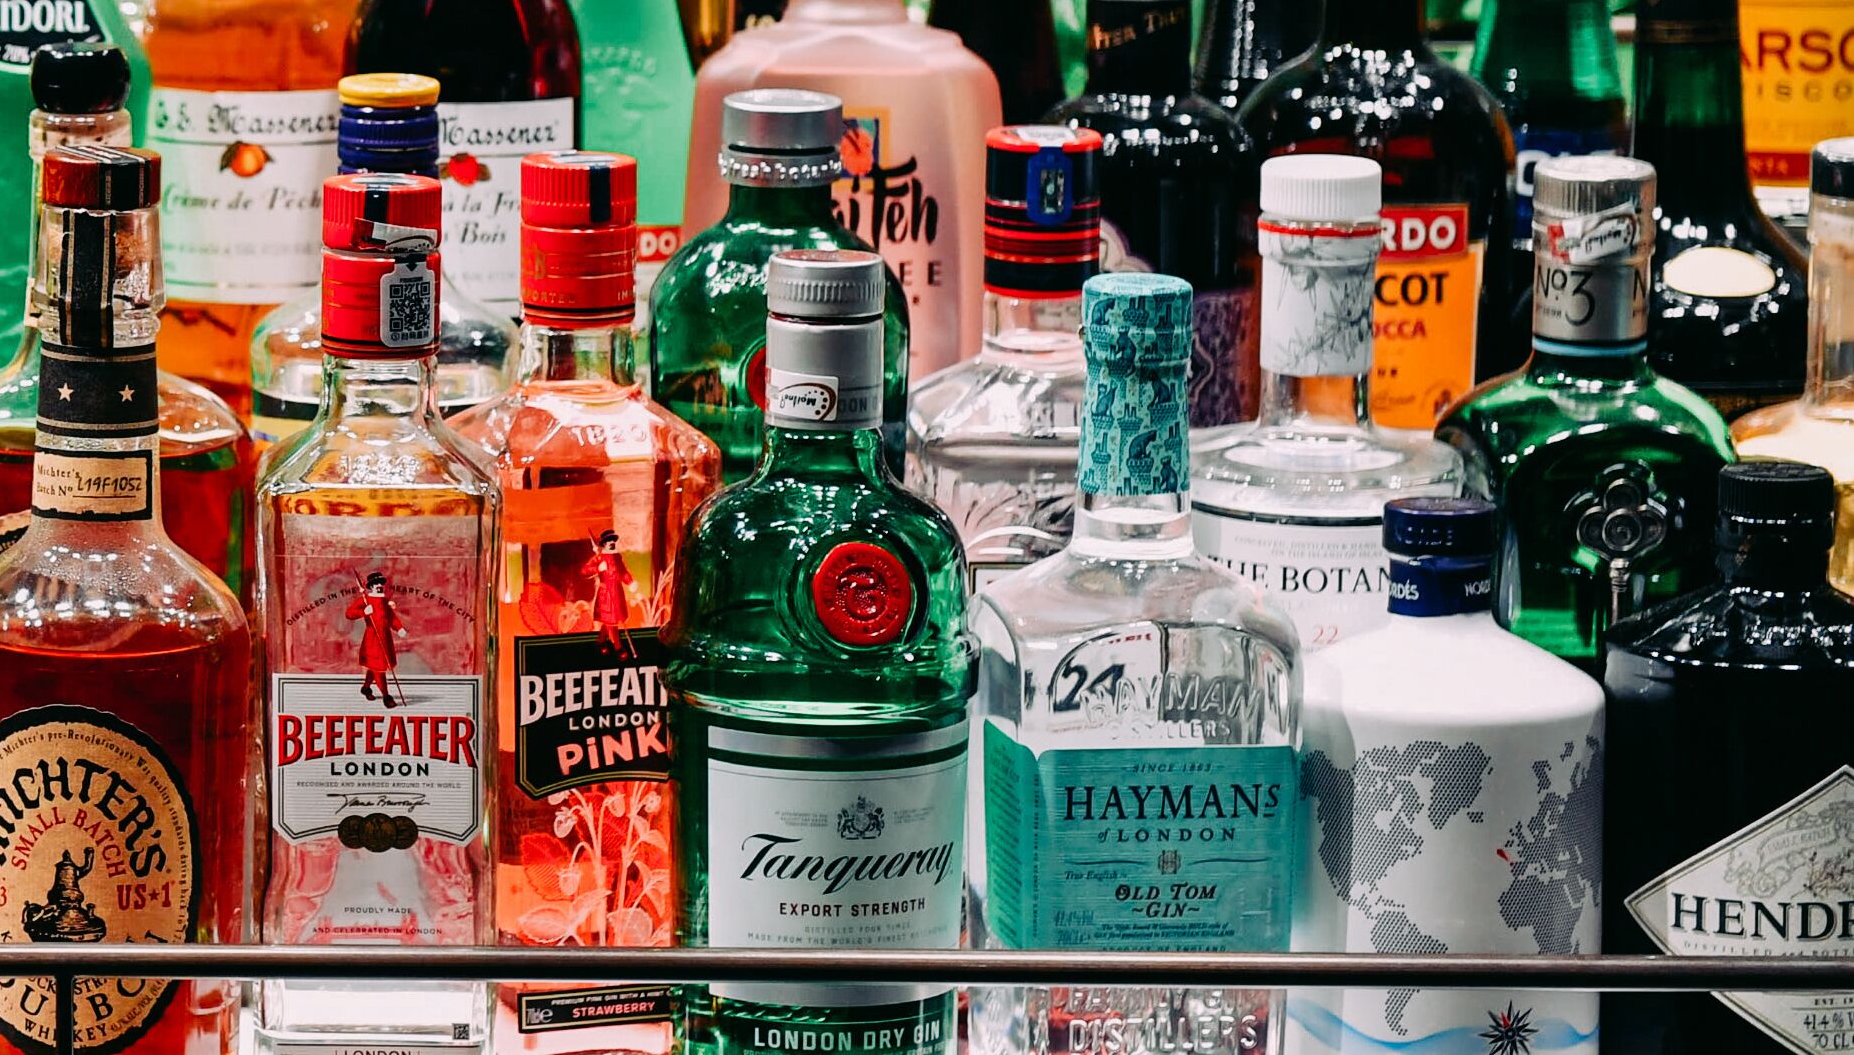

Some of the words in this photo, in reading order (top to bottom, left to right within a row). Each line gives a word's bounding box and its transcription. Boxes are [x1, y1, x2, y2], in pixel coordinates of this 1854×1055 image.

[227, 186, 251, 210] de
[459, 222, 507, 245] Bois
[1380, 216, 1457, 252] RDO
[1374, 272, 1450, 306] COT
[1565, 270, 1596, 327] 3
[1373, 320, 1426, 339] CCA
[286, 596, 326, 627] DISTILLED
[327, 592, 338, 602] IN
[389, 584, 420, 596] HEART
[422, 591, 435, 600] OF
[437, 597, 458, 611] THE
[456, 606, 476, 624] CITY
[520, 664, 669, 728] BEEFEAT
[568, 711, 659, 732] LONDON
[277, 712, 477, 769] BEEFEATER
[330, 761, 430, 778] LONDON
[11, 806, 66, 871] SMALL
[72, 808, 128, 879] BATCH
[1116, 827, 1237, 843] LONDON
[740, 832, 955, 895] Tanqueray
[1169, 881, 1219, 901] TOM
[344, 906, 384, 914] PROUDLY
[779, 902, 843, 917] EXPORT
[850, 897, 926, 918] STRENGTH
[312, 926, 331, 934] AND
[405, 927, 443, 935] LONDON
[571, 1001, 656, 1018] STRAWBERRY
[753, 1026, 852, 1051] LONDON
[863, 1027, 905, 1051] DRY
[913, 1019, 941, 1044] GIN
